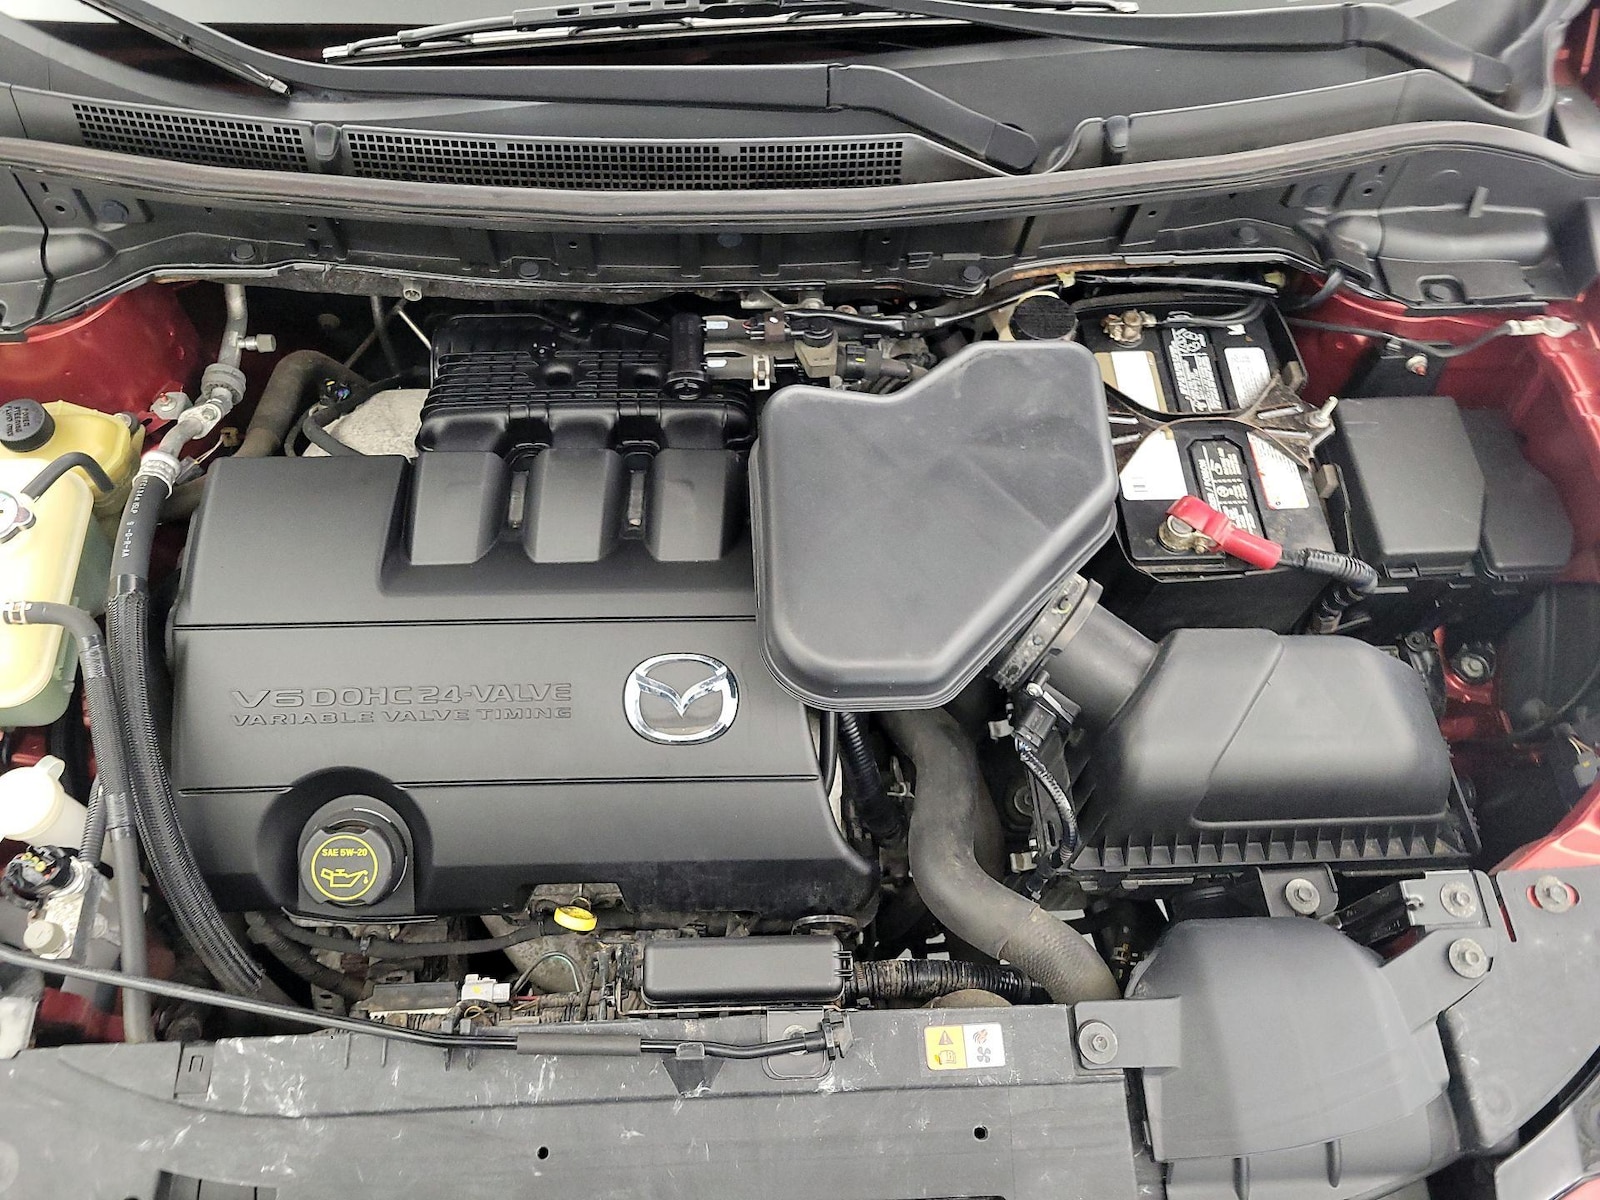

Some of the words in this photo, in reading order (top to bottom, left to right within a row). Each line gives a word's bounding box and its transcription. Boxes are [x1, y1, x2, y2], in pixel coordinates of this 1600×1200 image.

[14, 406, 22, 433] STEERING
[22, 408, 30, 427] POWER
[231, 689, 304, 709] V6
[309, 686, 412, 707] DOHC
[417, 683, 572, 704] 24-VALVE
[232, 711, 375, 727] VARIABLE
[382, 709, 470, 723] VALVE
[476, 707, 572, 721] TIMING
[321, 848, 339, 857] SAE
[340, 847, 368, 857] 5W-20
